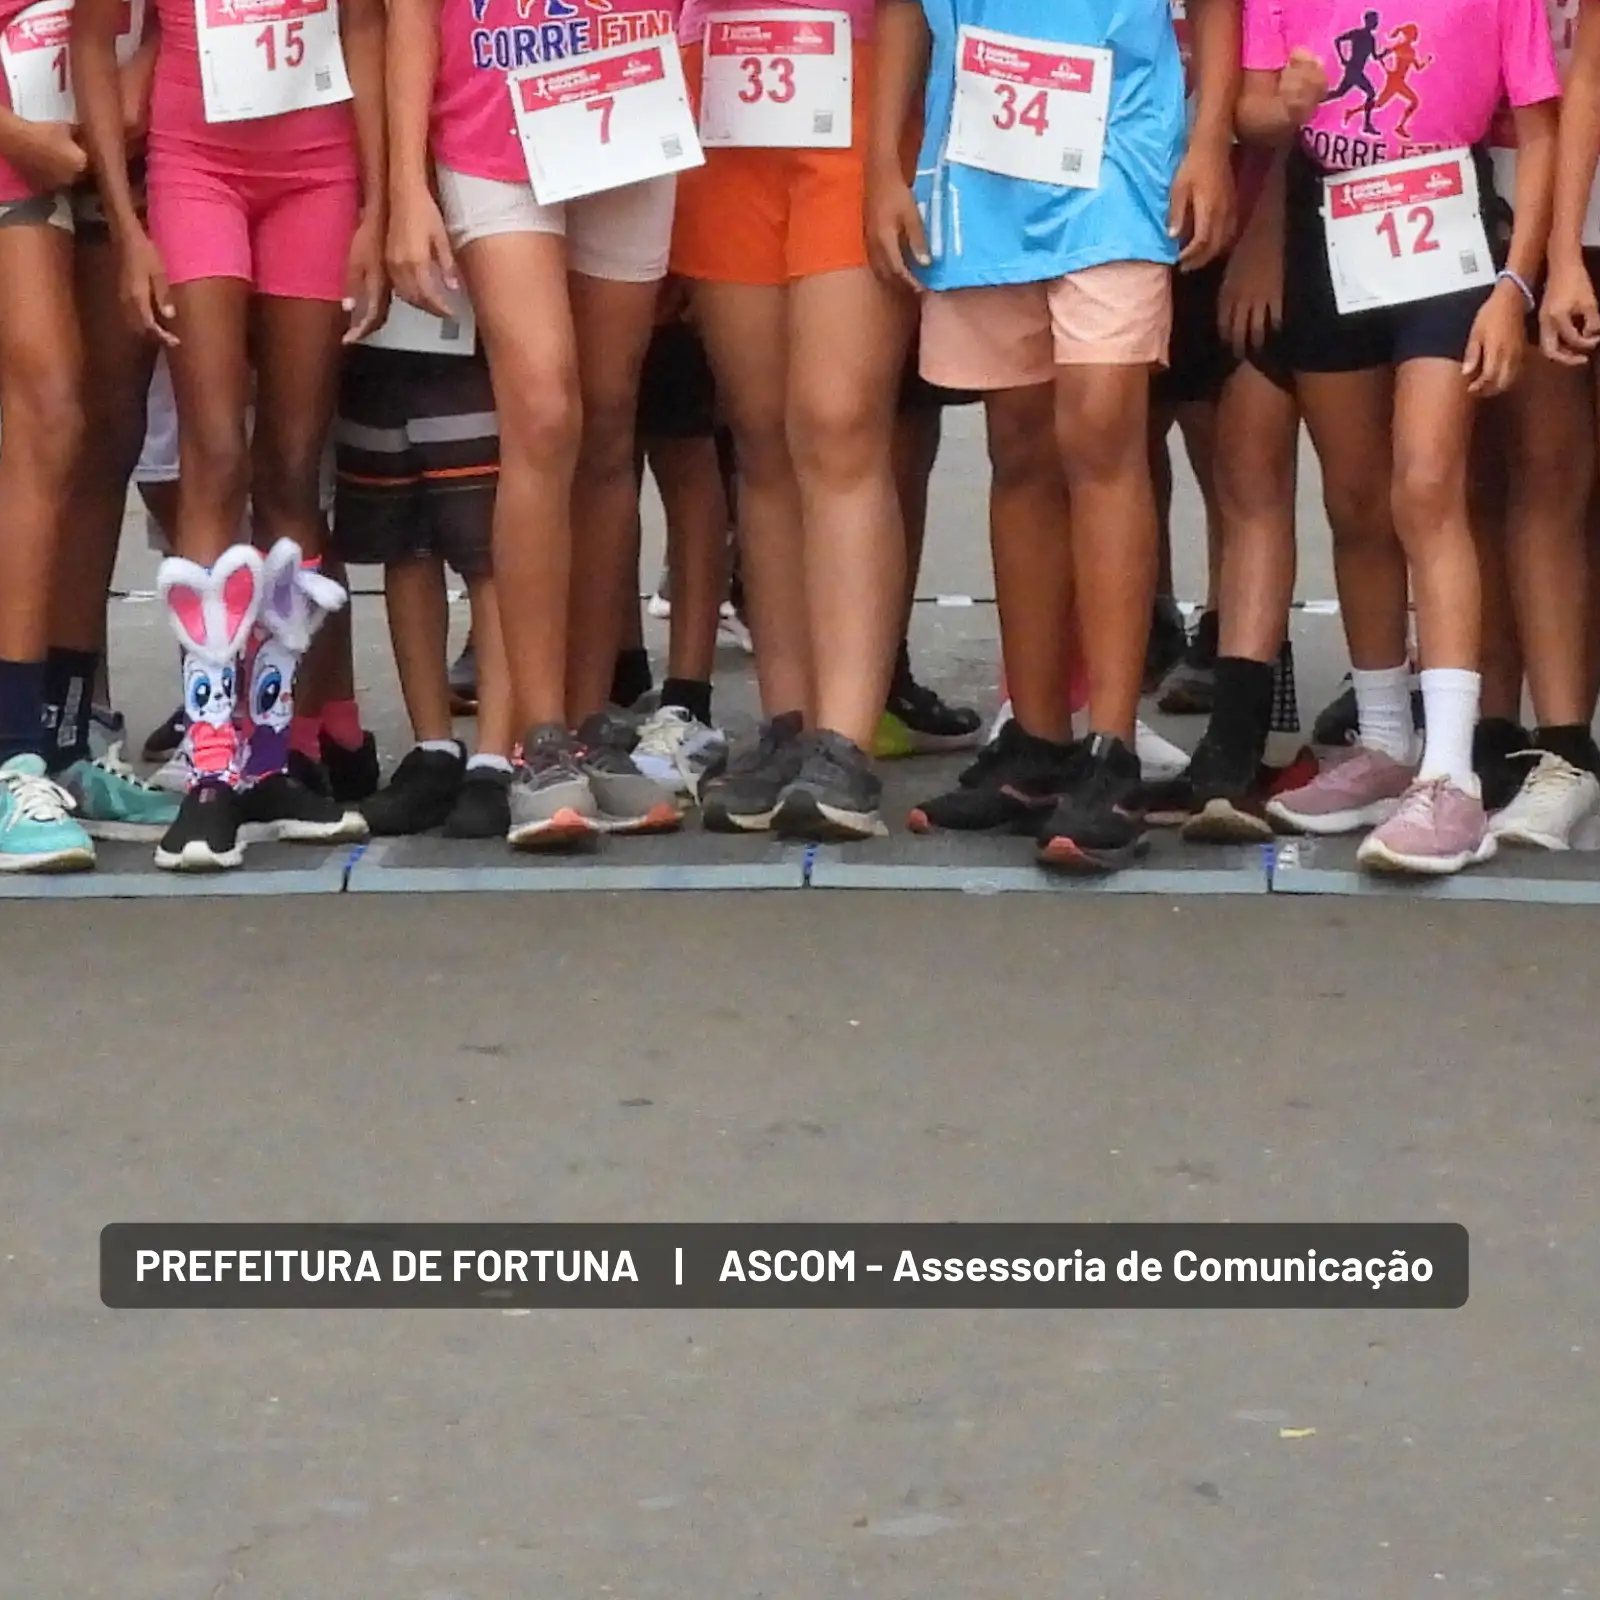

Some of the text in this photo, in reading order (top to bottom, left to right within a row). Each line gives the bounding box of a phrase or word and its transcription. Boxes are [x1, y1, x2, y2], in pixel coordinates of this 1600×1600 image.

[256, 20, 305, 72] 15
[472, 21, 592, 70] CORRE
[738, 56, 796, 104] 33
[585, 96, 615, 145] 7
[992, 83, 1050, 137] 34
[1375, 206, 1441, 258] 12
